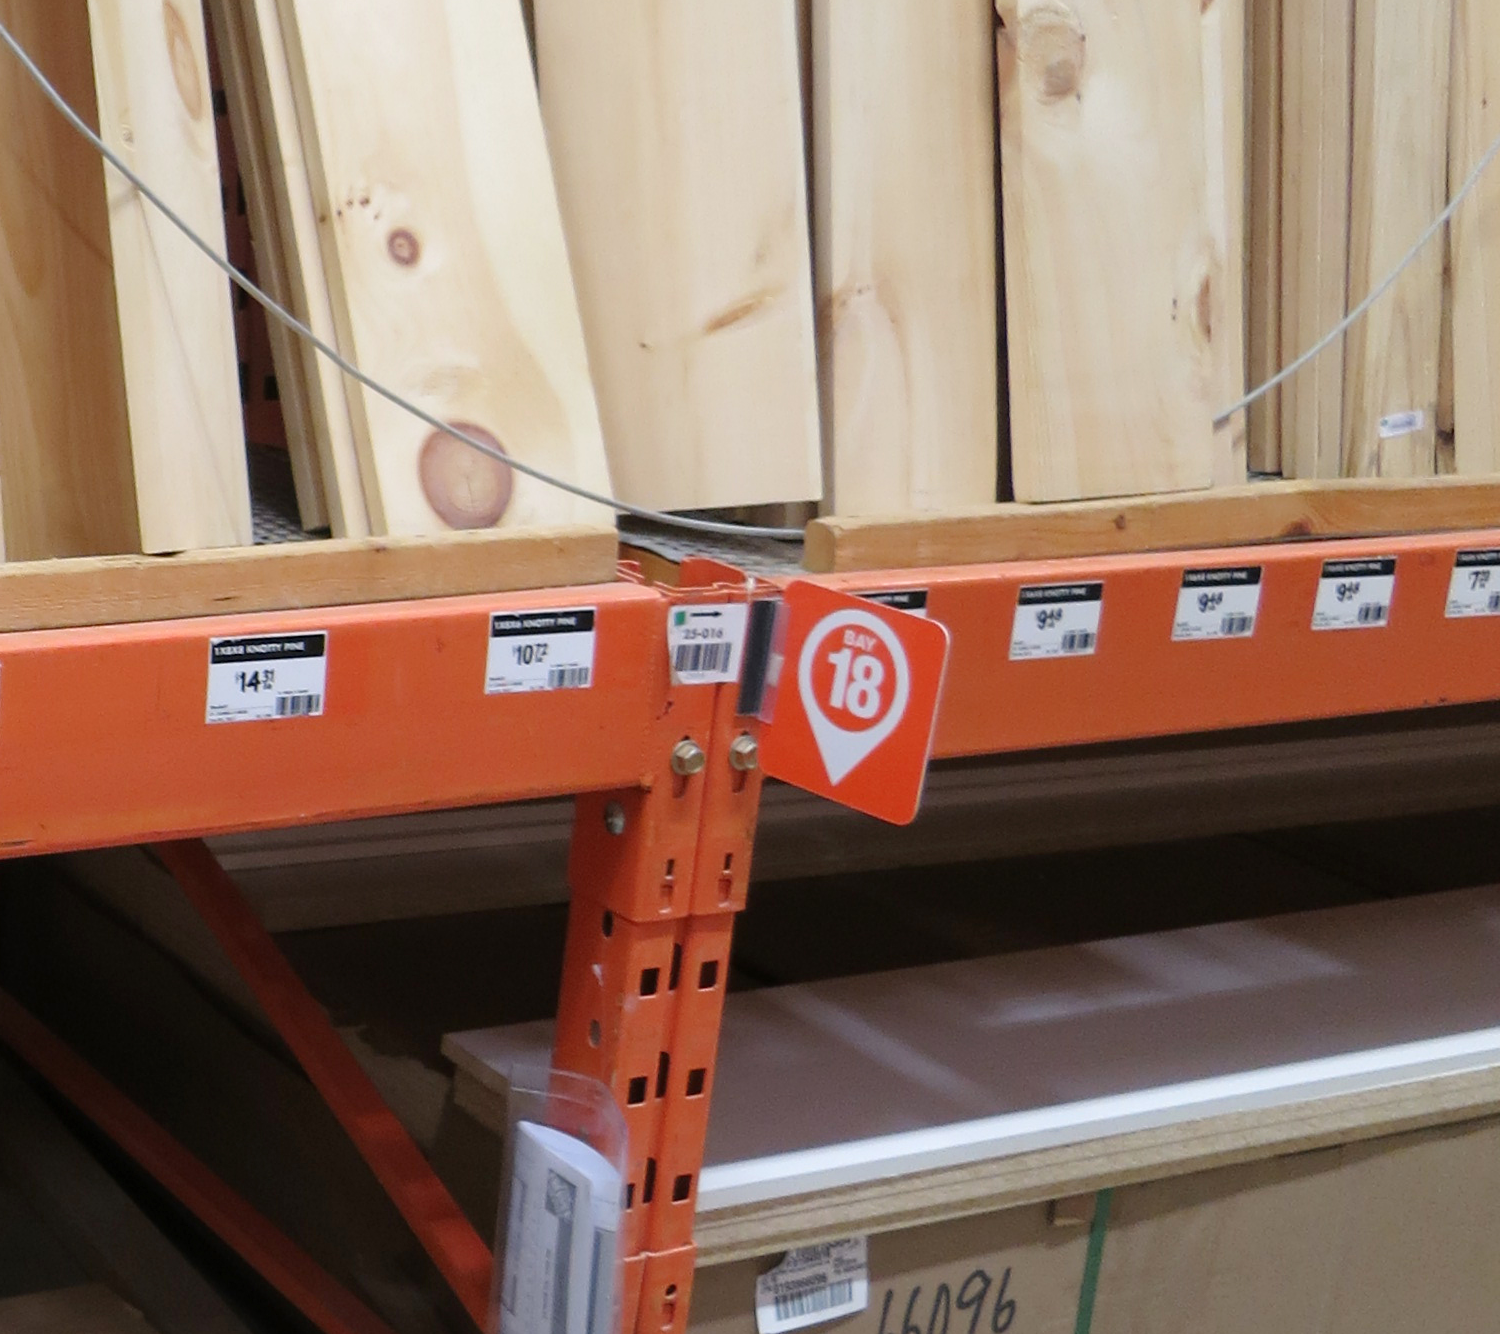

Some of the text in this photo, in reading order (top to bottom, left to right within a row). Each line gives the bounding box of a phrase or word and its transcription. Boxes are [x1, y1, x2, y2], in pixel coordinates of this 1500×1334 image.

[245, 643, 282, 654] KNOTTY
[283, 641, 305, 651] PINE
[843, 629, 877, 652] BAY
[827, 647, 885, 720] 18
